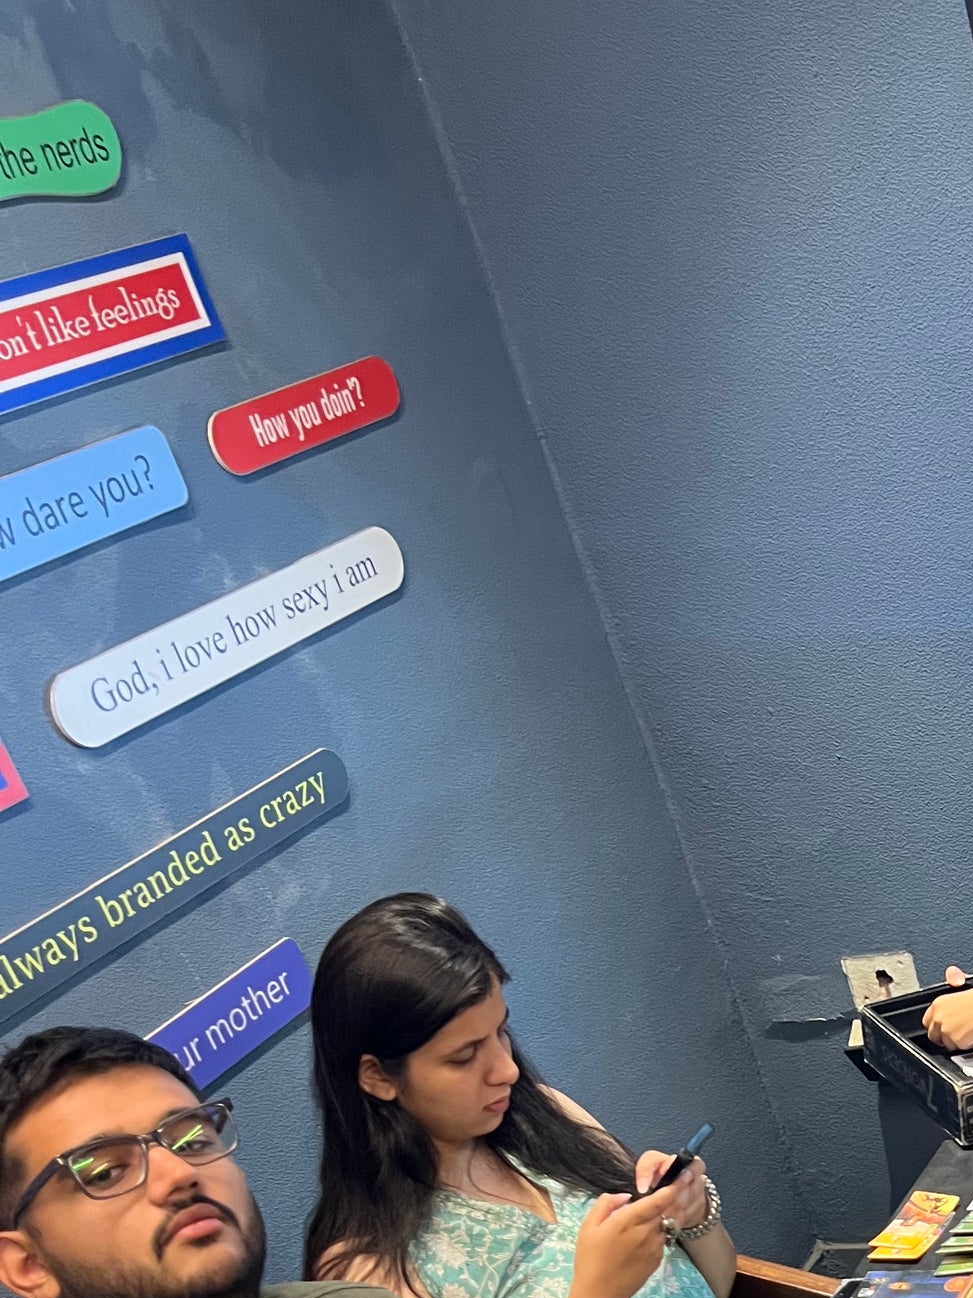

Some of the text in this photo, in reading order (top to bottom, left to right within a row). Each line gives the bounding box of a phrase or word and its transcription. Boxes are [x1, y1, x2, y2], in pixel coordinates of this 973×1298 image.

[40, 126, 110, 172] nerds
[33, 306, 91, 347] like
[88, 286, 181, 332] feelings
[248, 376, 365, 448] How you doin'?
[22, 497, 89, 536] dare
[88, 454, 154, 518] you?
[90, 556, 379, 712] God, i love how sexy i am
[0, 771, 326, 999] always branded as crazy
[205, 971, 290, 1050] mother
